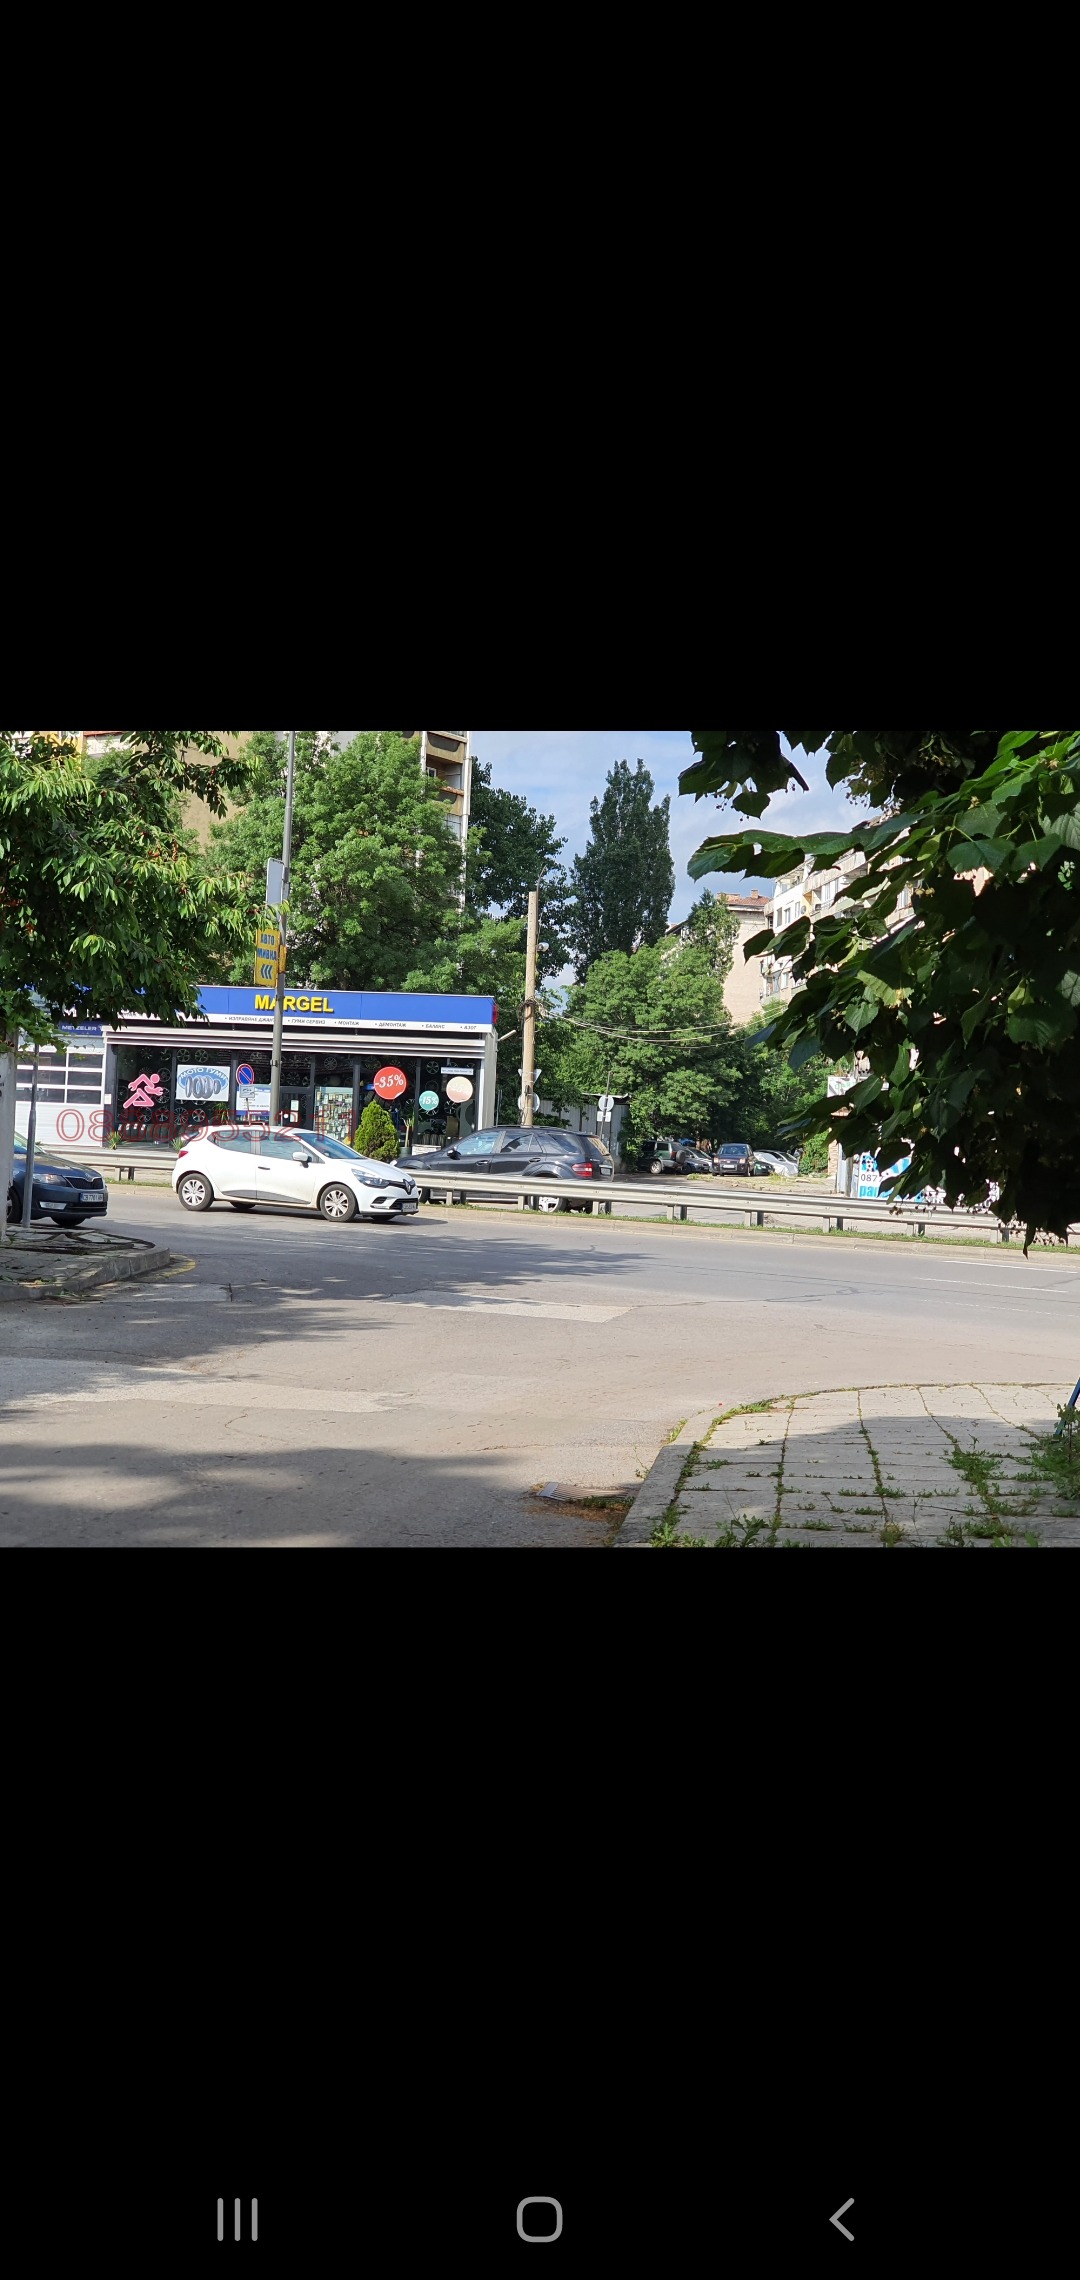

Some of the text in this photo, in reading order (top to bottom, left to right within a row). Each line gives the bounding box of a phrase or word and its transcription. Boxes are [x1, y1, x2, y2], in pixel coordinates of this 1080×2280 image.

[261, 933, 275, 945] АВТО
[181, 1067, 228, 1081] МОТО ГУМИ
[374, 1074, 404, 1089] -35%
